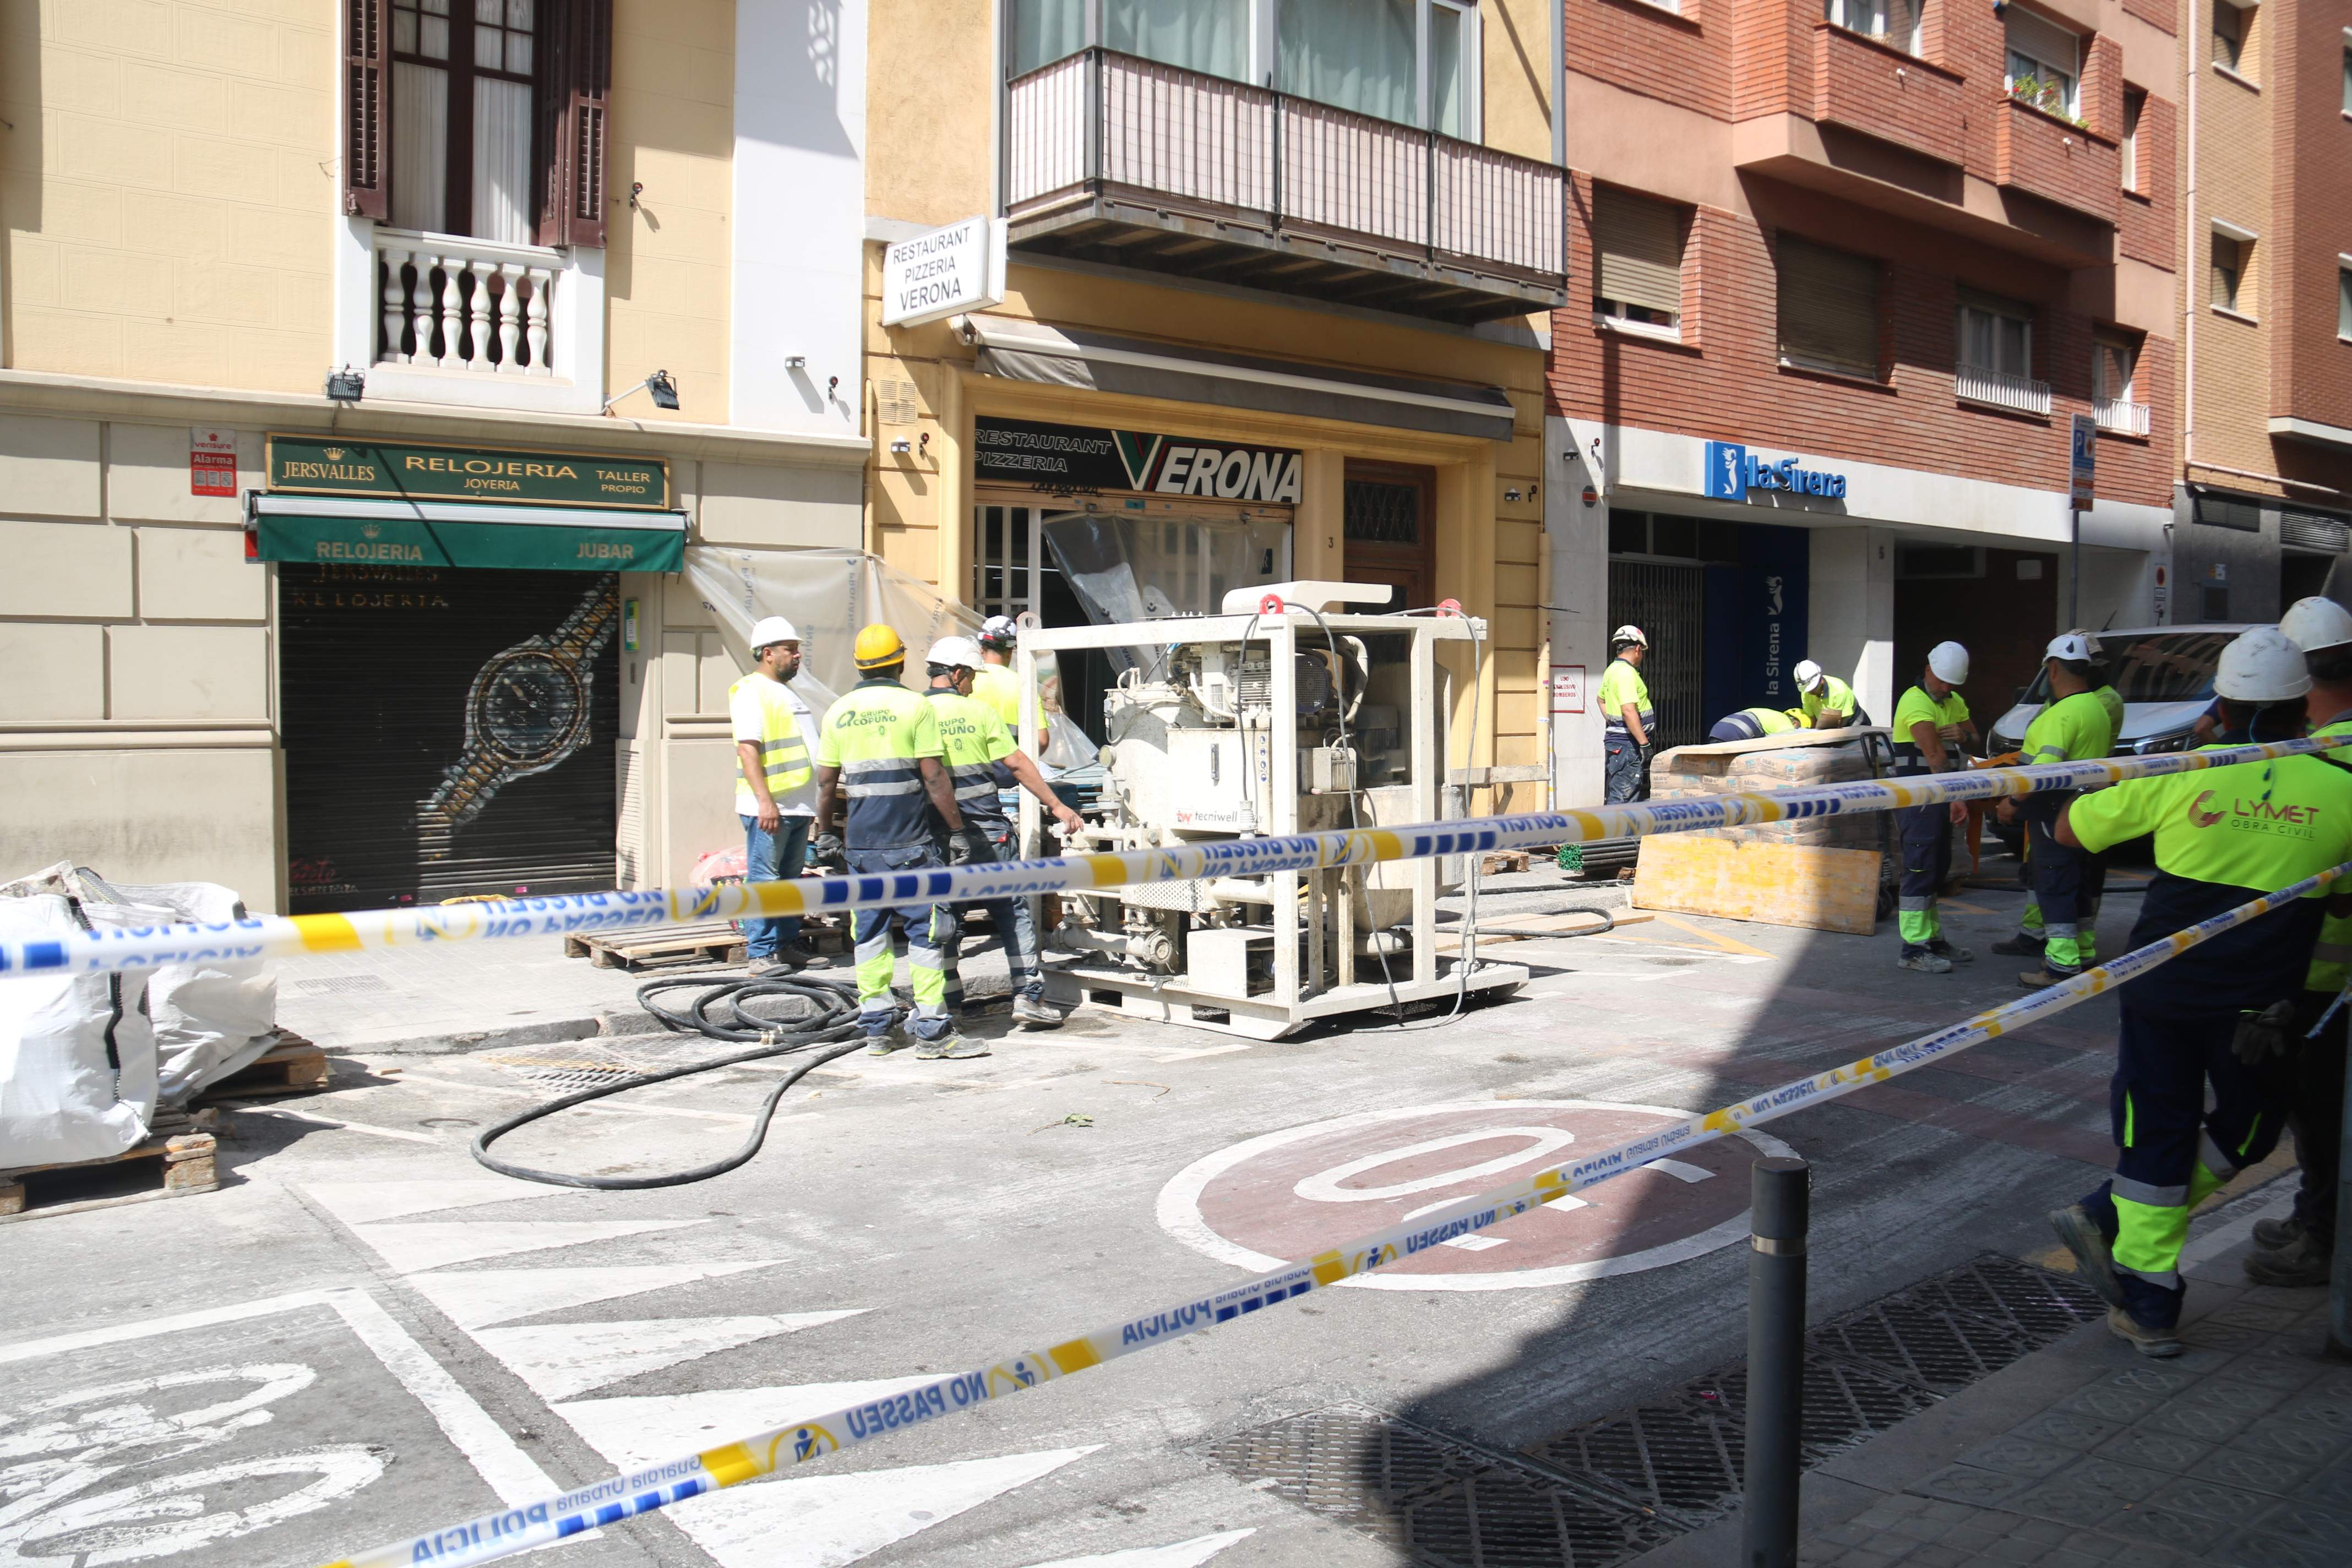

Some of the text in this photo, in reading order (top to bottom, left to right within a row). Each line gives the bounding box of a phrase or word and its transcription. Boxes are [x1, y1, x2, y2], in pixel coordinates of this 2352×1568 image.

[894, 226, 970, 264] RESTAURANT
[905, 256, 956, 284] PIZZERIA
[900, 277, 961, 311] VERONA
[975, 429, 1112, 454] RESTAURANT
[2076, 432, 2082, 454] P
[194, 454, 232, 464] Alarma
[406, 456, 578, 478] RELOJERIA
[975, 451, 1068, 472] PIZZERIA
[1111, 429, 1302, 504] VERONA
[282, 461, 374, 481] JERSVALLES
[596, 470, 650, 482] TALLER
[464, 478, 520, 491] JOYERIA
[601, 484, 645, 493] PROPIO
[316, 542, 423, 560] RELOJERIA
[576, 543, 634, 558] JUBAR
[1328, 537, 1333, 549] 3
[1766, 623, 1780, 695] la Sirena
[854, 715, 897, 726] COPUNO
[861, 709, 890, 718] GRUPO
[938, 717, 966, 727] RUPO
[940, 725, 976, 737] PUNO
[1195, 811, 1238, 822] tecniwell
[2234, 798, 2320, 825] LYMET
[2231, 819, 2315, 839] OBRA CIVIL
